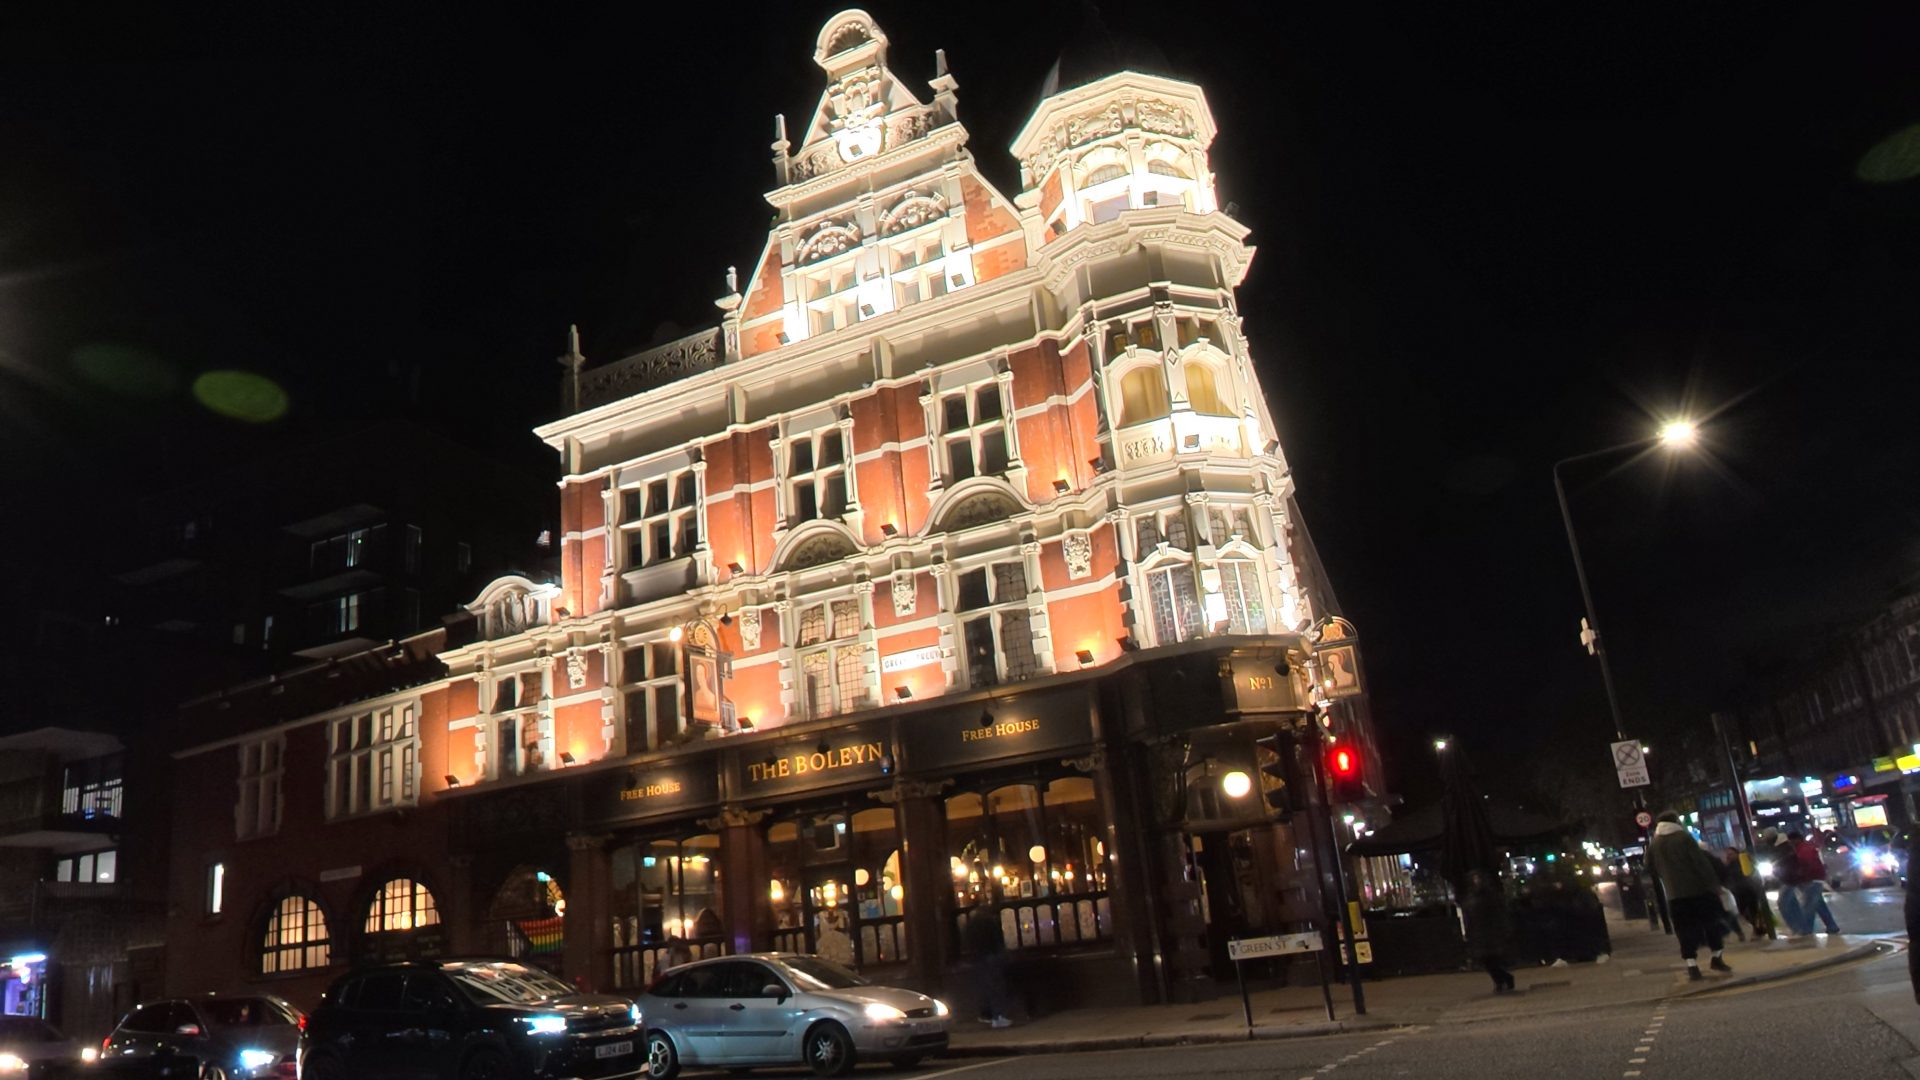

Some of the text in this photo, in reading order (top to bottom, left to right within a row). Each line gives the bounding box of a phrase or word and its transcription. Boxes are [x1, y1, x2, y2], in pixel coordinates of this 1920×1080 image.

[962, 719, 1040, 742] FREE HOUSE
[747, 742, 883, 782] THE BOLEYN
[1622, 776, 1647, 785] ENDS
[620, 782, 681, 801] FREE HOUSE
[1638, 815, 1650, 823] 20
[1239, 940, 1288, 954] GREEN ST
